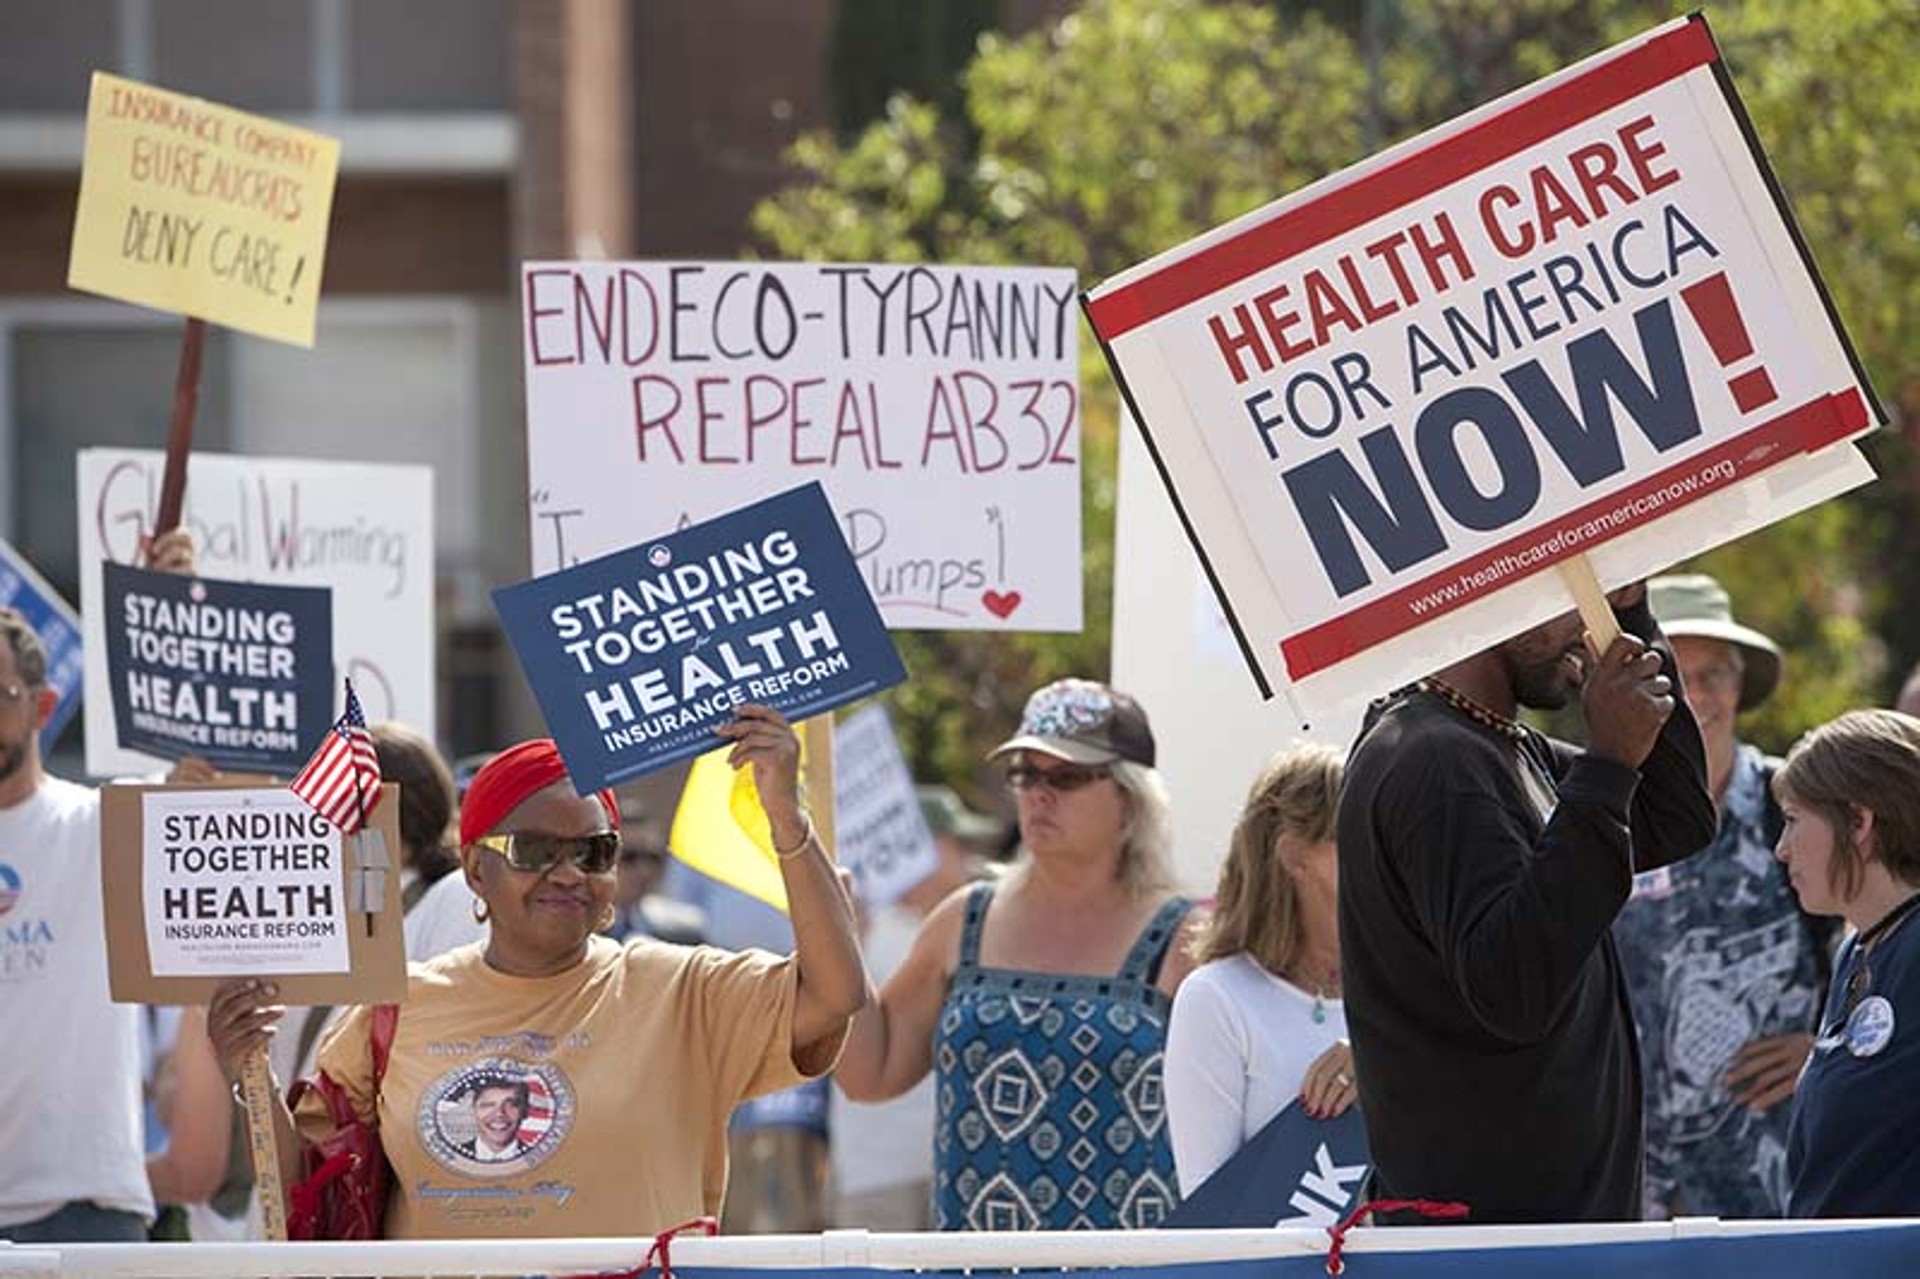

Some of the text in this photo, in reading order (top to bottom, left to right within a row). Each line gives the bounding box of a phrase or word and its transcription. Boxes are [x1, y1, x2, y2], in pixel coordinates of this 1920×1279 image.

[107, 88, 223, 146] INSURANCE
[131, 135, 304, 222] BUREAUCRATS
[122, 206, 200, 269] DENY
[1208, 114, 1682, 385] HEALTH CARE
[526, 268, 660, 367] END
[1244, 204, 1720, 461] FOR AMERICA
[632, 374, 901, 470] REPEAL
[1280, 270, 1780, 600] NOW!
[98, 461, 250, 568] Glbal
[259, 474, 406, 599] Warming
[1408, 457, 1736, 617] www.healthcareforamericanow.org
[124, 594, 295, 644] STANDING
[551, 530, 799, 639] STANDING
[564, 568, 814, 673] TOGETHER
[126, 629, 295, 680] TOGETHER
[585, 610, 840, 730] HEALTH
[127, 671, 297, 730] HEALTH
[214, 726, 298, 750] REFORM
[604, 652, 850, 752] INSURANCE REFORM
[164, 812, 330, 842] STANDING
[165, 844, 331, 873] TOGETHER
[164, 884, 333, 919] HEALTH
[165, 921, 336, 940] INSURANCE REFORM
